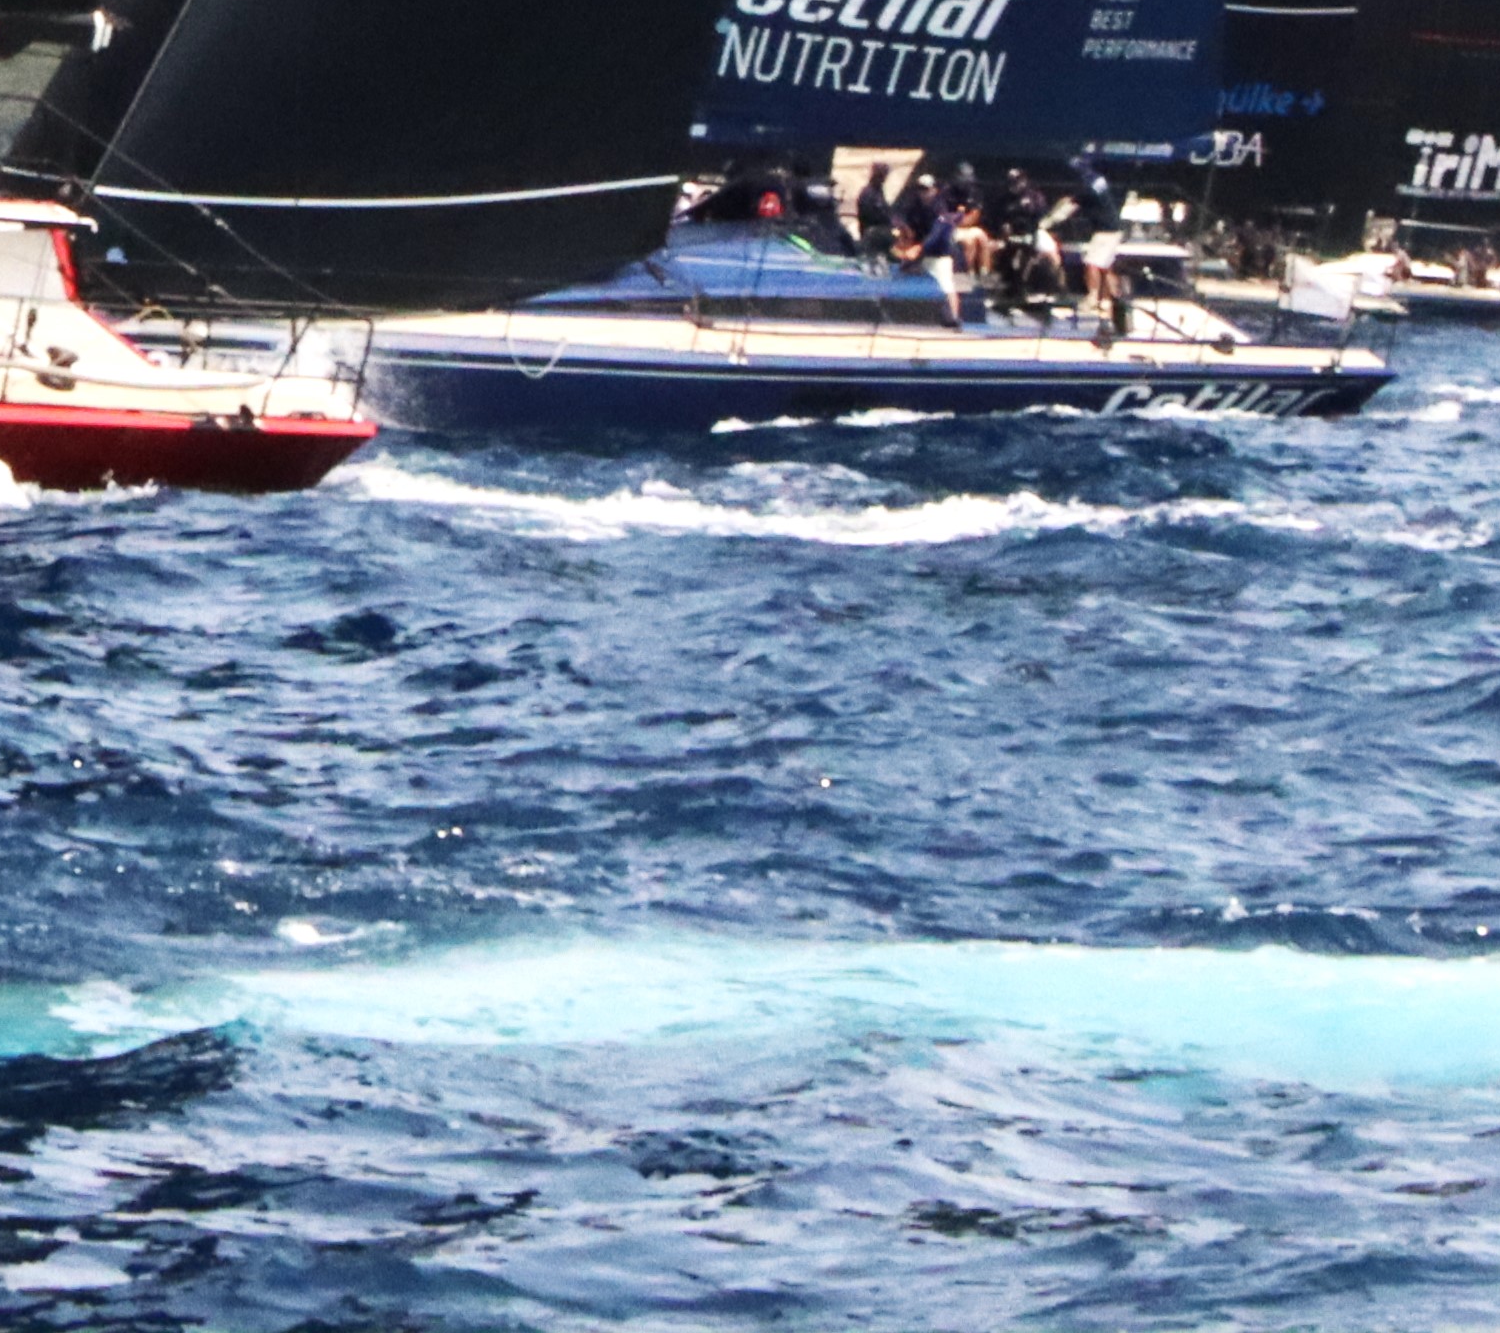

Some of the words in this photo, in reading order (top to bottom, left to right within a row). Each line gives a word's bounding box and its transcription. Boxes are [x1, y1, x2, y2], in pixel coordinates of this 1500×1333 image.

[1089, 8, 1135, 30] BEST
[1082, 37, 1198, 61] PERFORMANCE
[717, 24, 1007, 104] NUTRITION
